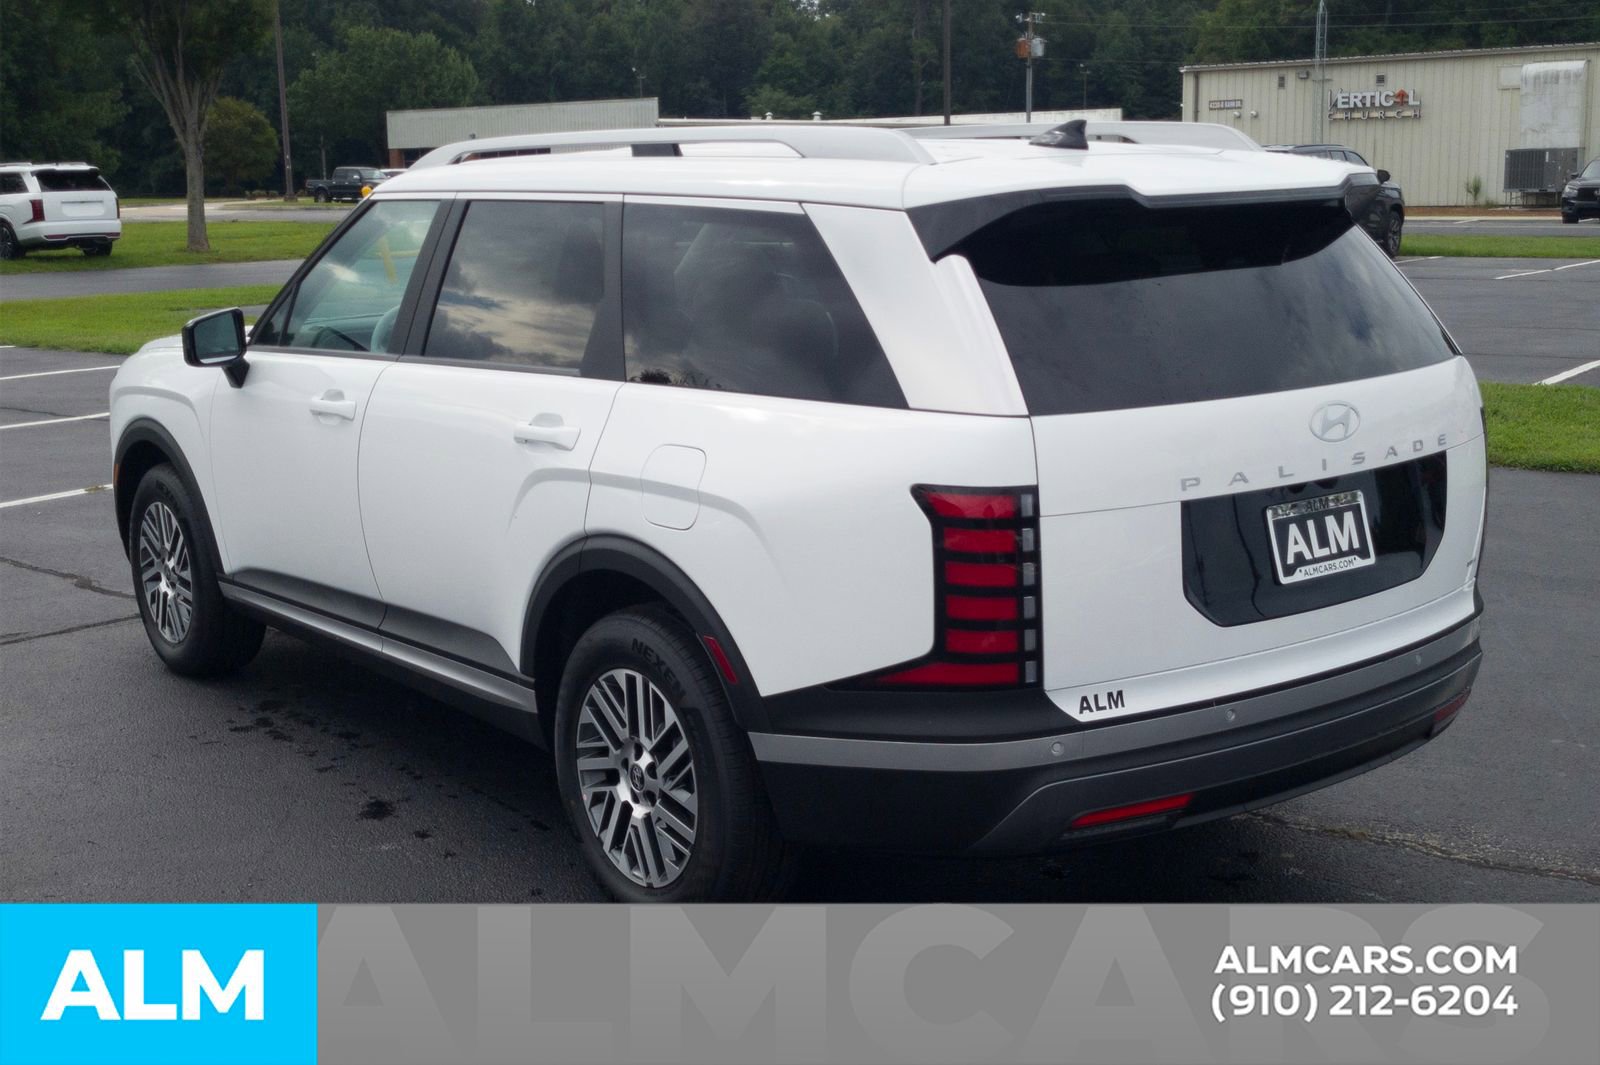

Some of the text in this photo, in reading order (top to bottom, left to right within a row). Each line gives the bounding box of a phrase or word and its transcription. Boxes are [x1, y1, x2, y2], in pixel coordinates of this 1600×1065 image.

[1328, 109, 1421, 121] CHURCH
[1180, 434, 1446, 492] PALISADE
[1305, 497, 1330, 513] ALM
[1286, 511, 1360, 565] ALM
[1303, 558, 1354, 577] ALMCARS.COM
[1079, 689, 1125, 714] ALM
